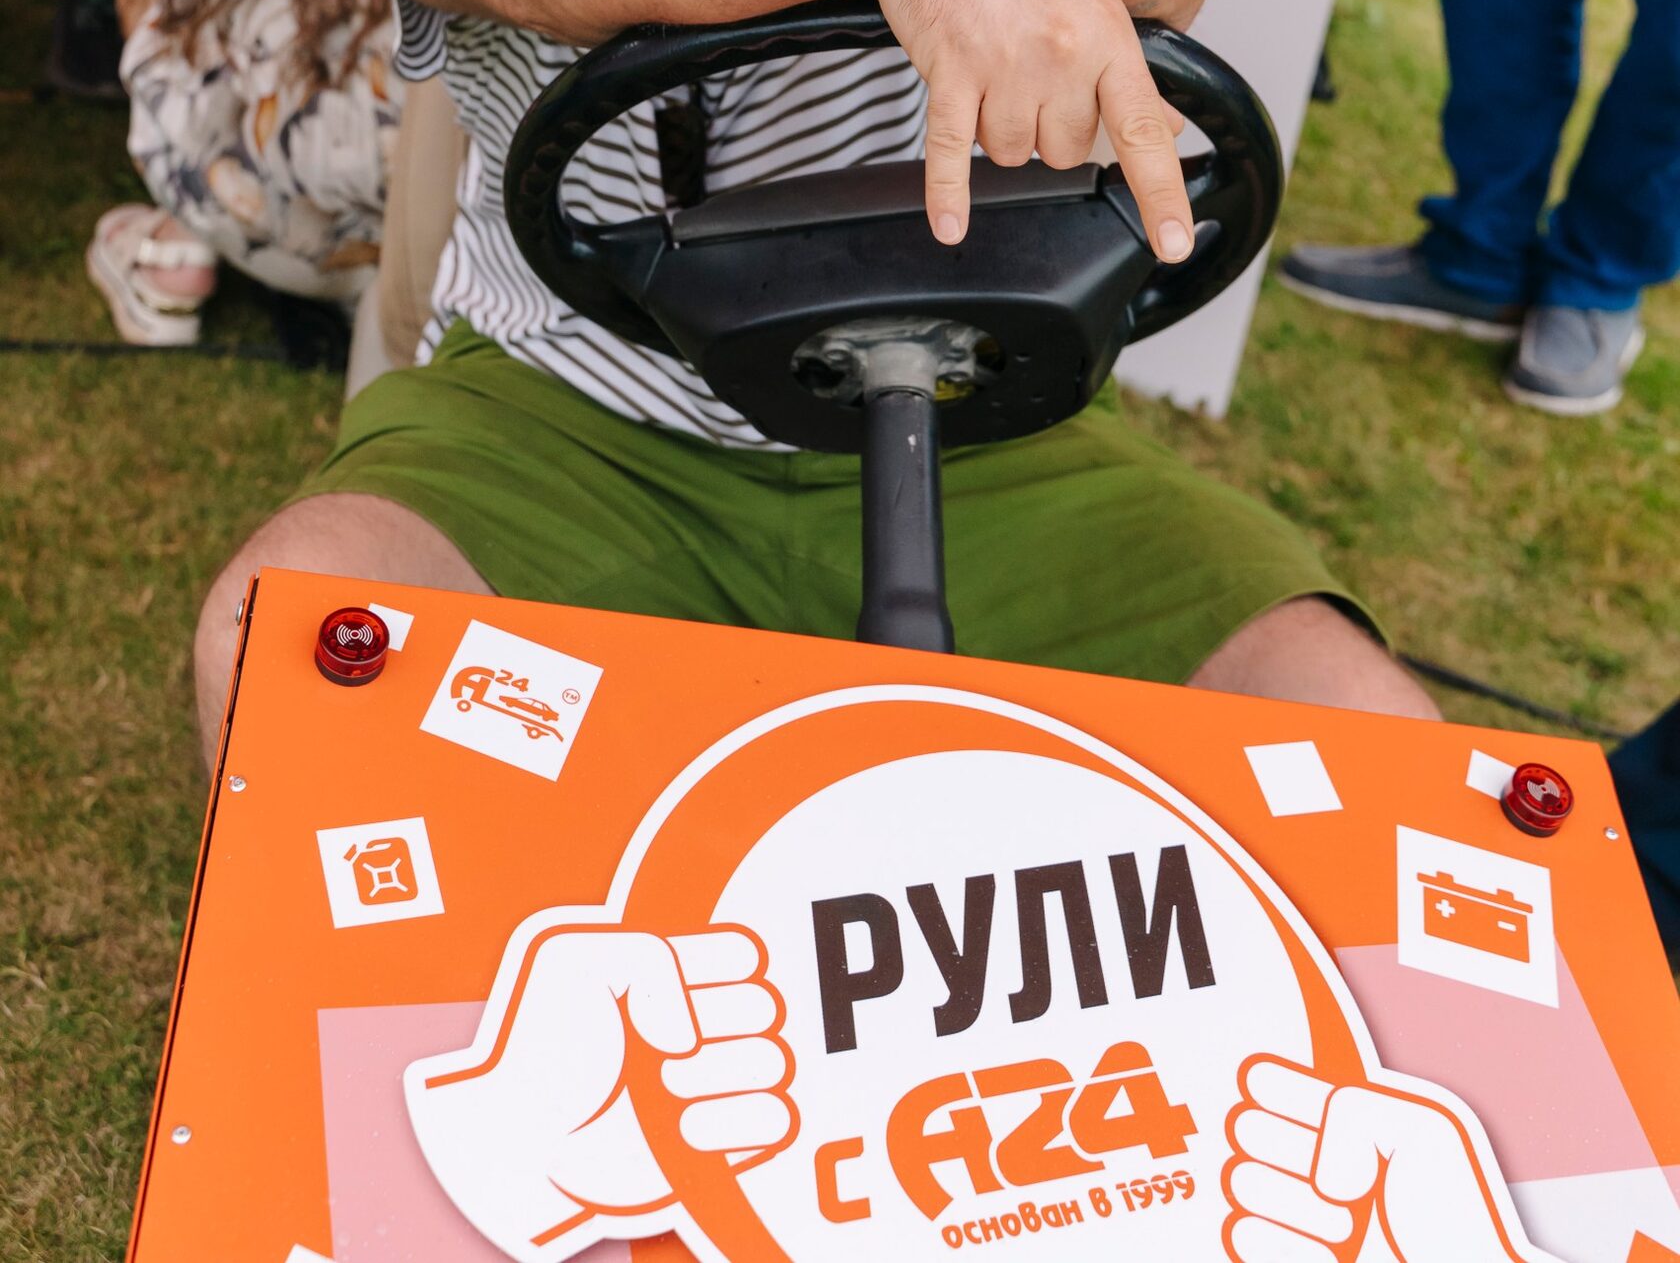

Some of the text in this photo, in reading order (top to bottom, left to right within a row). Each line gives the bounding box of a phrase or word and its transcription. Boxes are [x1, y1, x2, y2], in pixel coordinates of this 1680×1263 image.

[811, 844, 1217, 1055] РУЛИ
[941, 1170, 1195, 1249] основан в 1999
